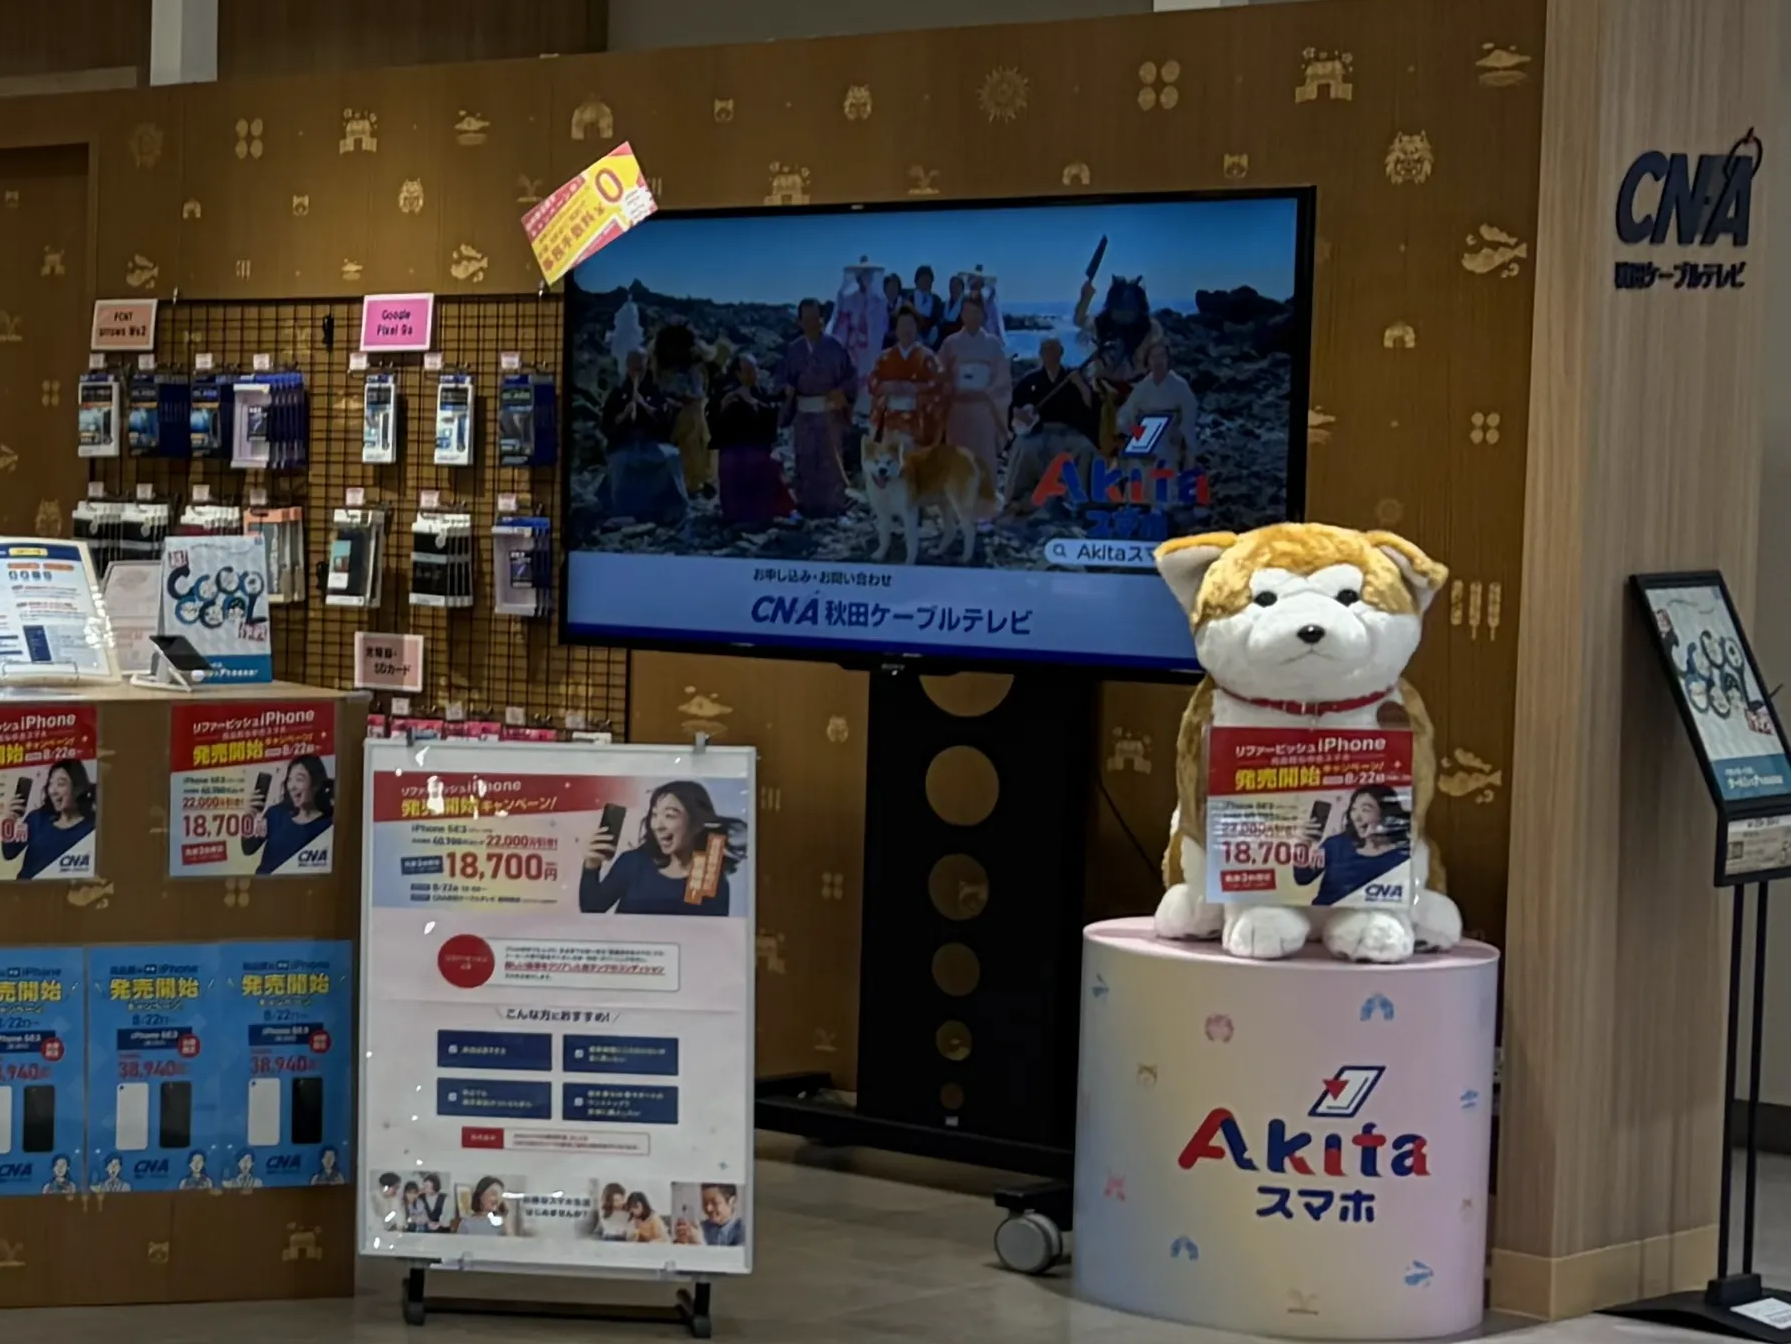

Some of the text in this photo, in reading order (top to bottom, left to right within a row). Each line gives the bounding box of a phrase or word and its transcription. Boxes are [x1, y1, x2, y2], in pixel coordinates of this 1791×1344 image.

[1615, 149, 1755, 247] CNA
[381, 309, 411, 321] Google
[376, 324, 398, 336] Pixel
[1031, 452, 1211, 506] Akita
[1084, 508, 1169, 539] スマホ
[750, 593, 1034, 636] CNA 秋田ケーブルテレビ
[192, 739, 264, 767] 発売開始
[1235, 767, 1322, 791] 発売開始
[59, 854, 90, 867] CNA
[297, 848, 328, 863] CNA
[445, 851, 558, 882] 18,700円
[1365, 883, 1403, 899] CNA
[109, 977, 201, 1001] 発売開始
[241, 973, 331, 997] 発売開始
[1176, 1106, 1432, 1178] Akita
[133, 1159, 170, 1174] CNA
[266, 1155, 302, 1170] CNA
[1255, 1185, 1376, 1223] スマホ
